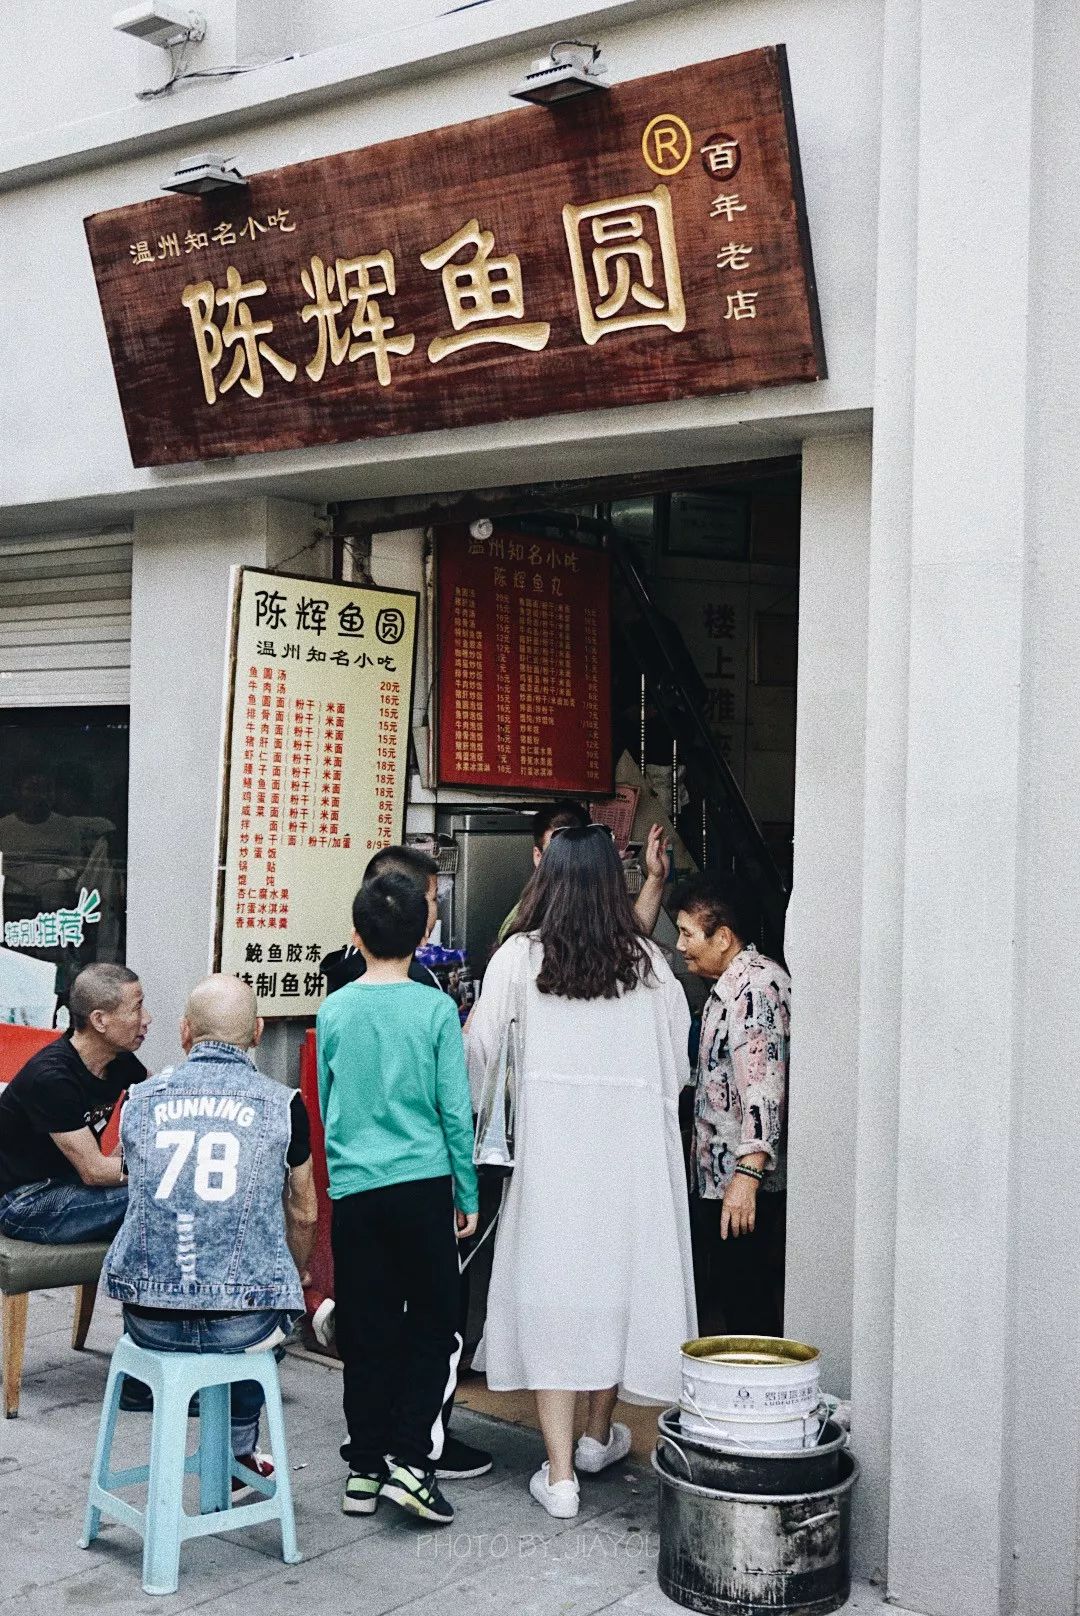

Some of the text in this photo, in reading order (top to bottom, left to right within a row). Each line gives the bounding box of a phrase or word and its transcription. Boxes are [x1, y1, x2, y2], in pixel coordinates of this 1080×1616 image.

[128, 208, 297, 267] 温州知名小吃
[700, 137, 759, 322] 百年老店
[181, 184, 687, 406] 陈辉鱼圆
[468, 538, 579, 574] 温州知名小吃
[493, 566, 563, 597] 陈辉鱼丸
[254, 590, 405, 645] 陈辉鱼圆
[256, 640, 397, 673] 温州知名小吃
[248, 681, 287, 695] 牛肉汤
[5, 908, 84, 948] 特别推荐
[153, 1098, 257, 1129] RUNNING
[154, 1130, 240, 1201] 78
